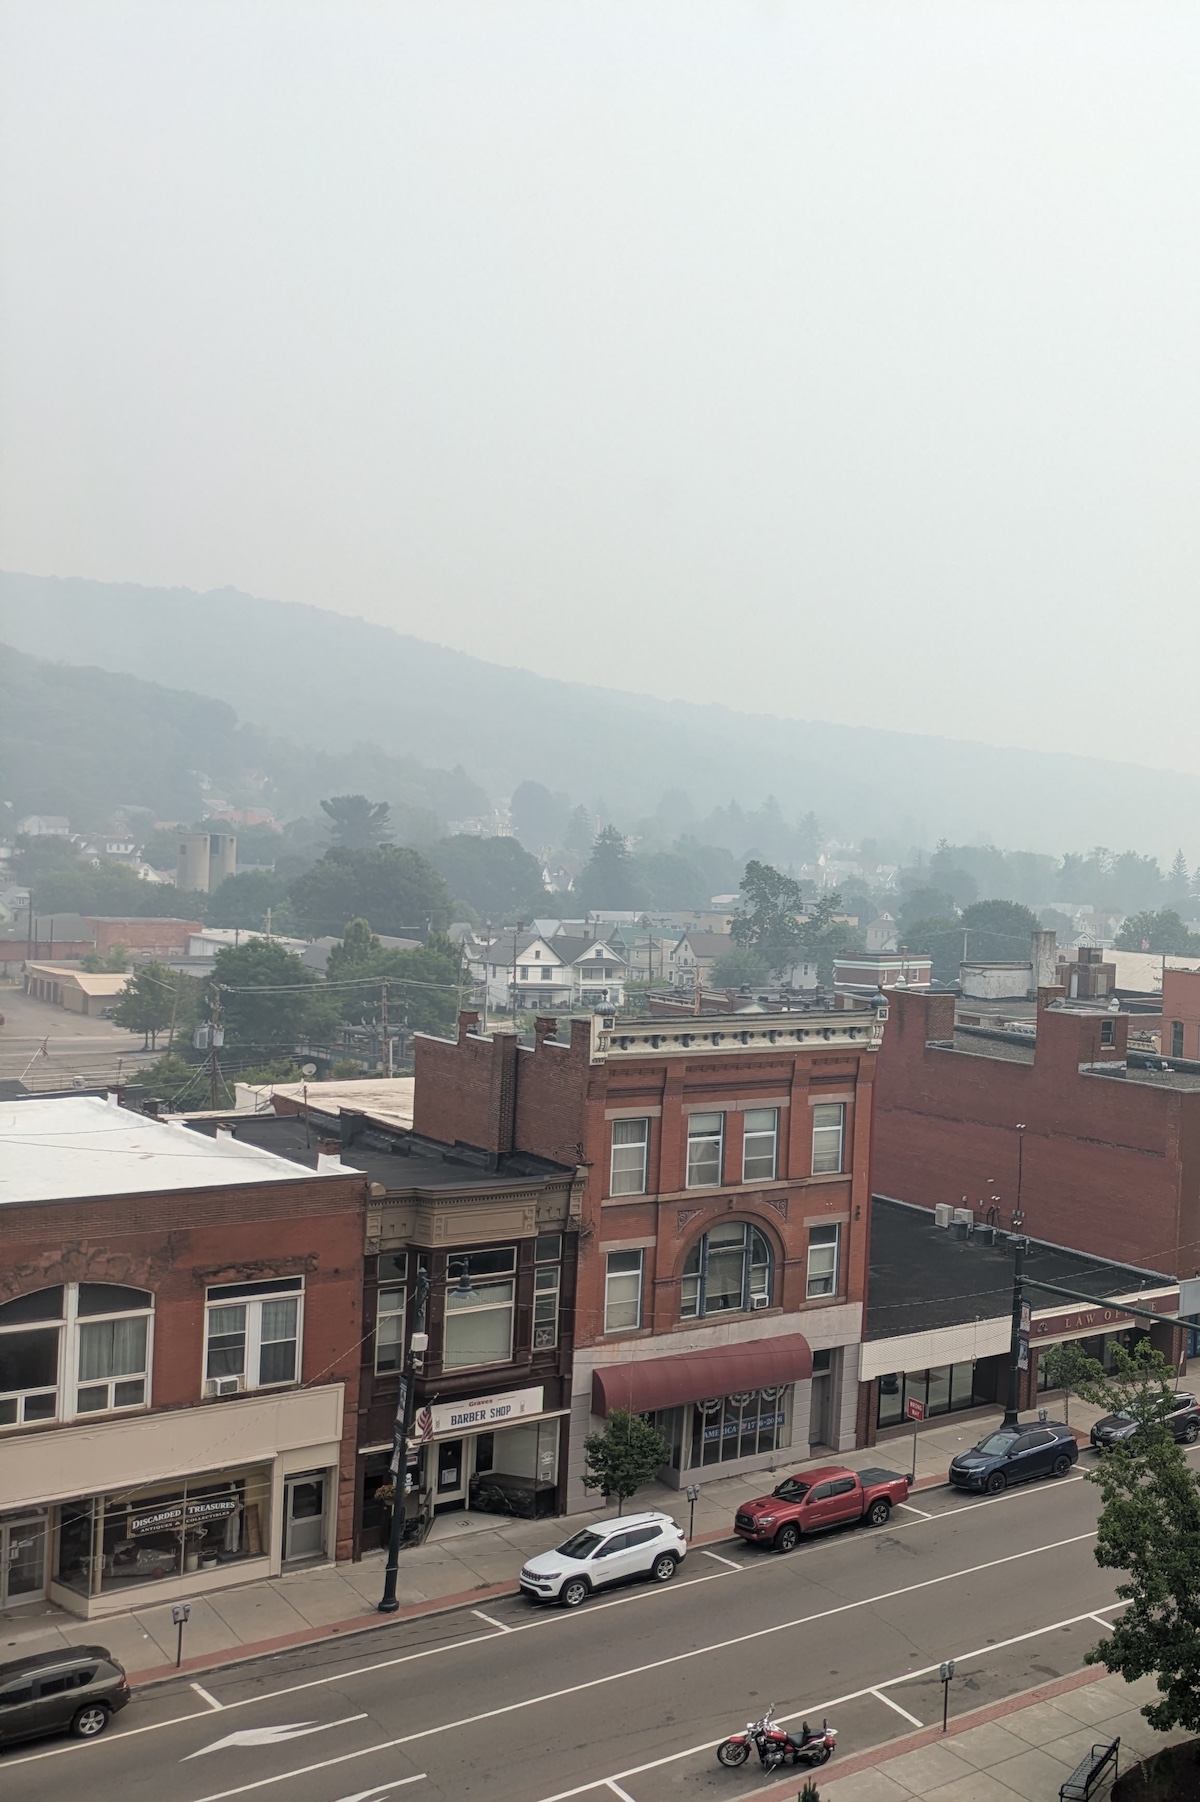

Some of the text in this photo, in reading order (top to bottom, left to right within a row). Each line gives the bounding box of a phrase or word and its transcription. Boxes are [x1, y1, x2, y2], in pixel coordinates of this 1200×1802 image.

[1065, 1314, 1095, 1328] LAW
[468, 1399, 493, 1407] Graves
[450, 1405, 511, 1426] BARBER SHOP
[704, 1426, 737, 1439] AMEICA
[132, 1501, 235, 1530] DISCARDED TREASURES
[140, 1523, 173, 1533] ANTIQUES
[186, 1510, 230, 1523] COLLECTIBLES
